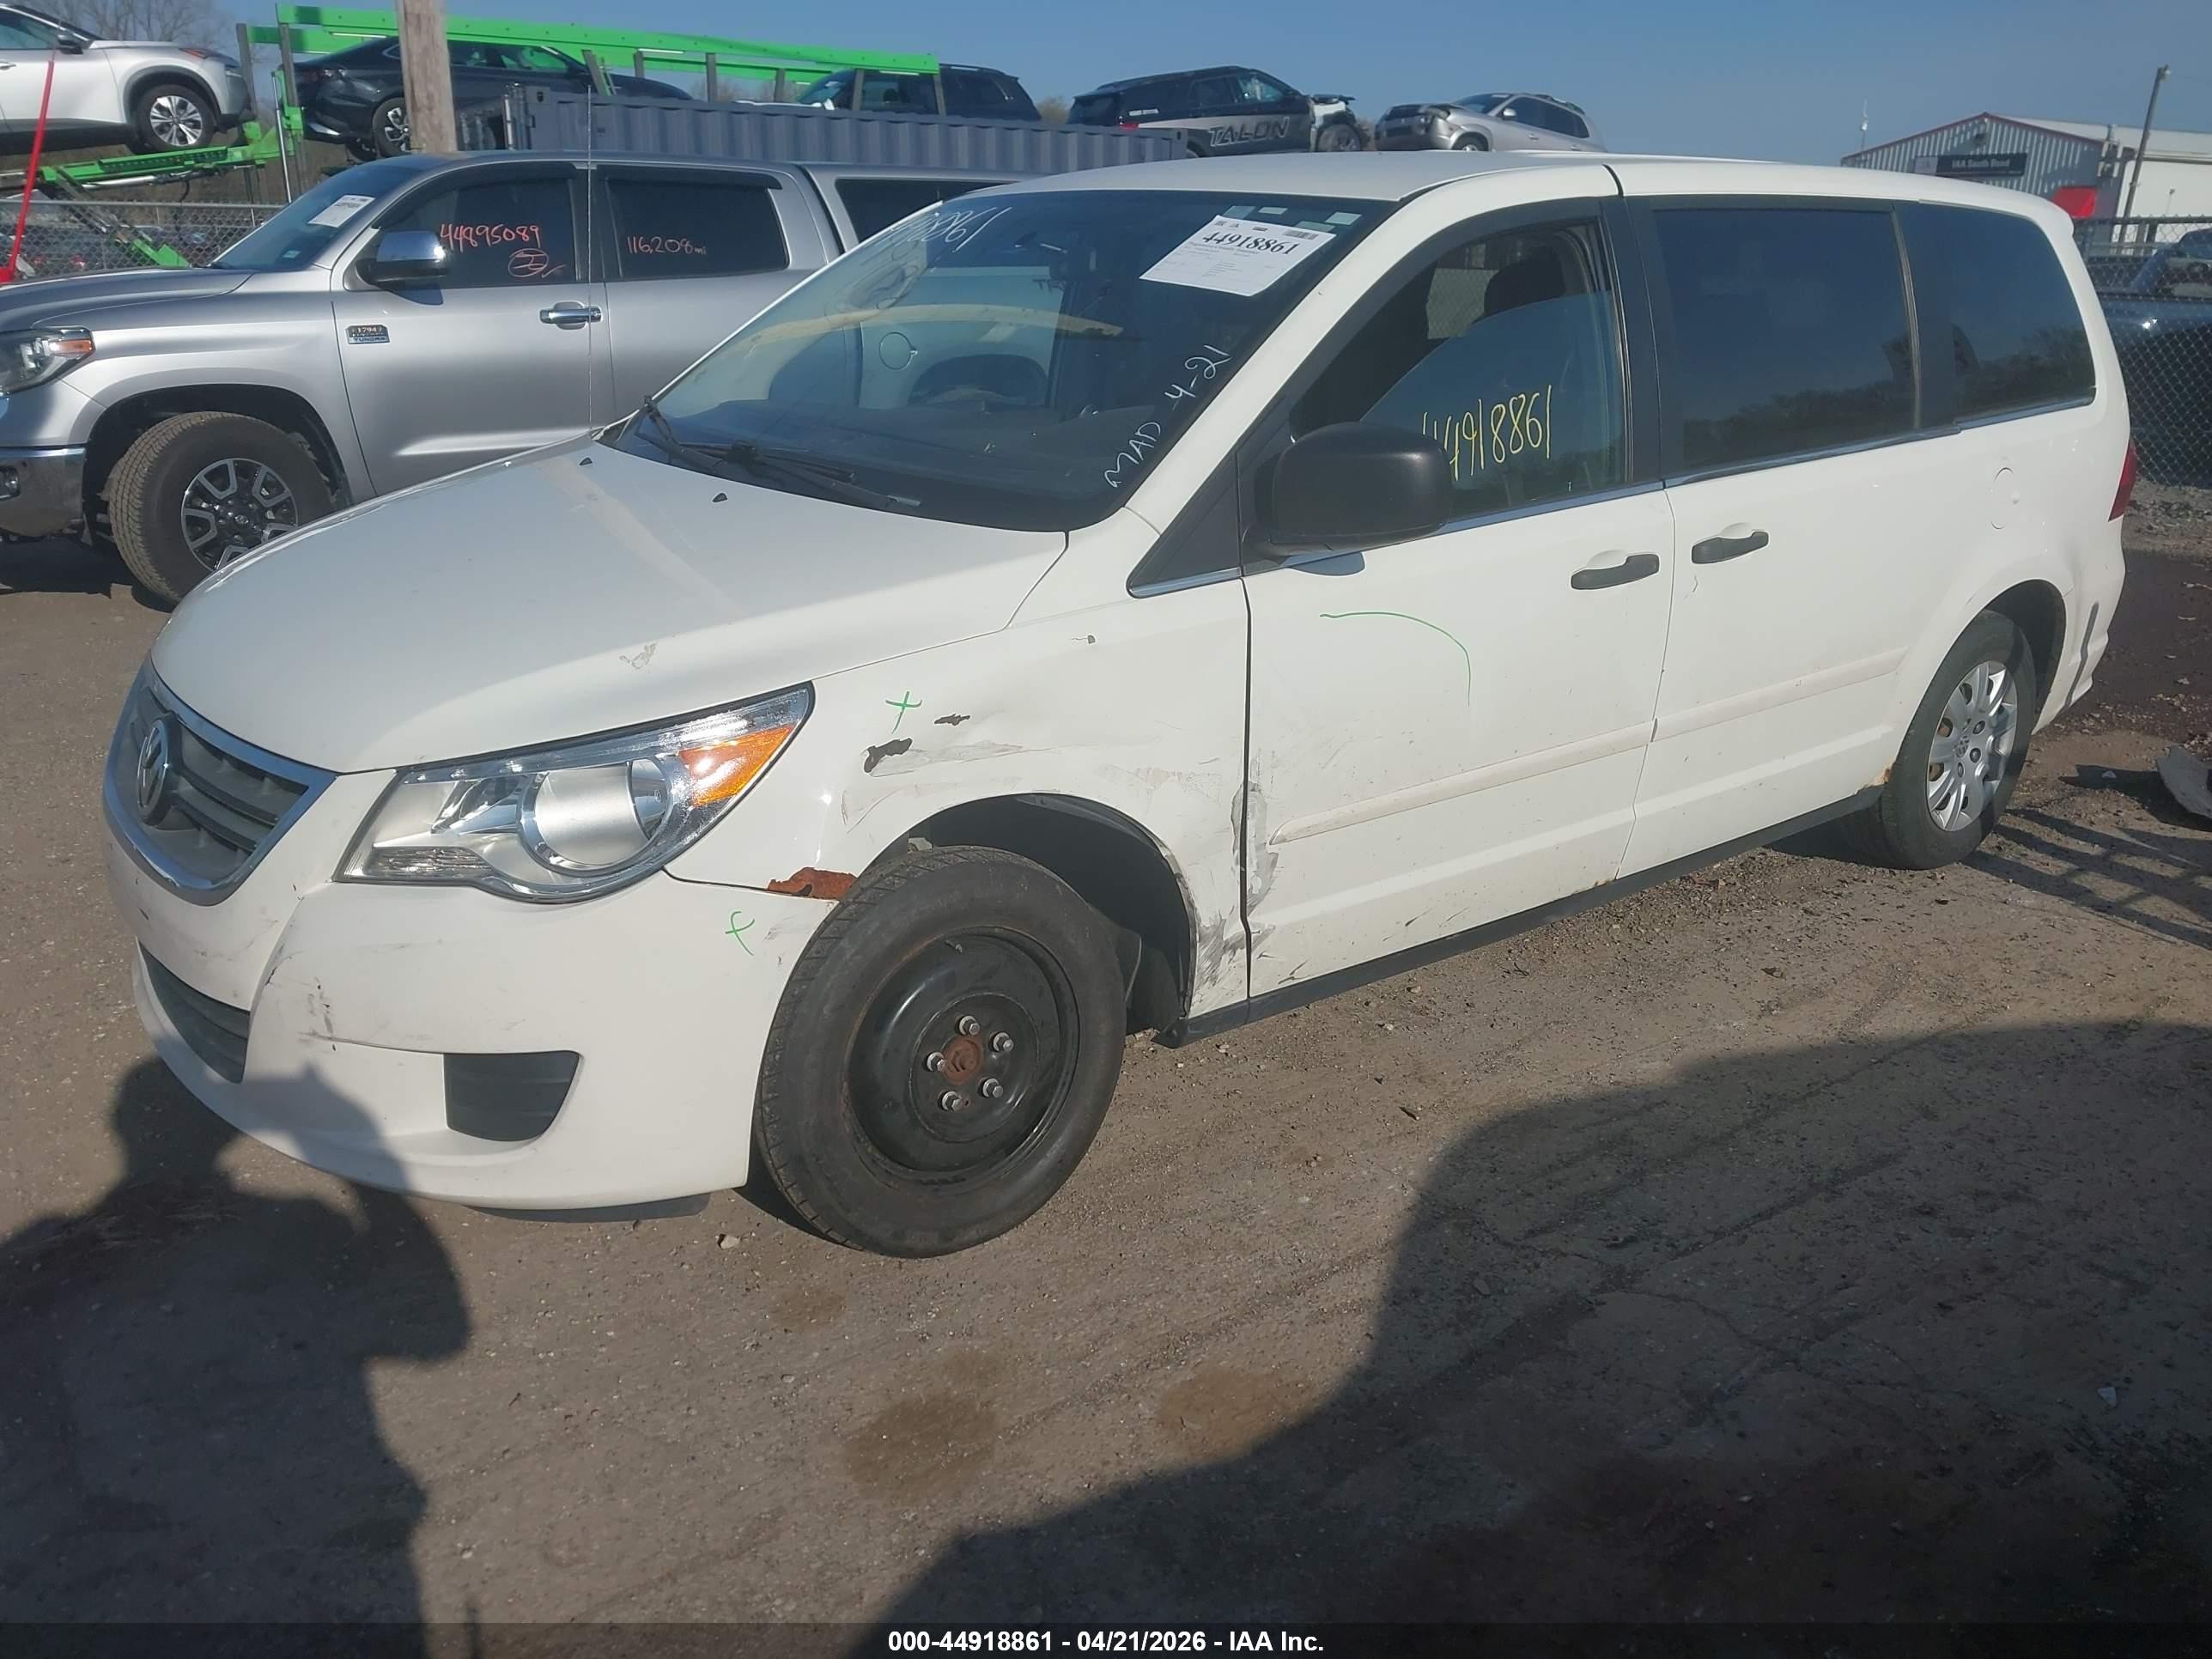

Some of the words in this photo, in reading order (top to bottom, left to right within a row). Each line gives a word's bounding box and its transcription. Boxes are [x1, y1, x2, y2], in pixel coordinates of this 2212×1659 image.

[1208, 116, 1290, 148] TALON
[440, 223, 541, 253] 44895089
[1202, 231, 1301, 255] 44918861
[1104, 422, 1162, 488] MAD
